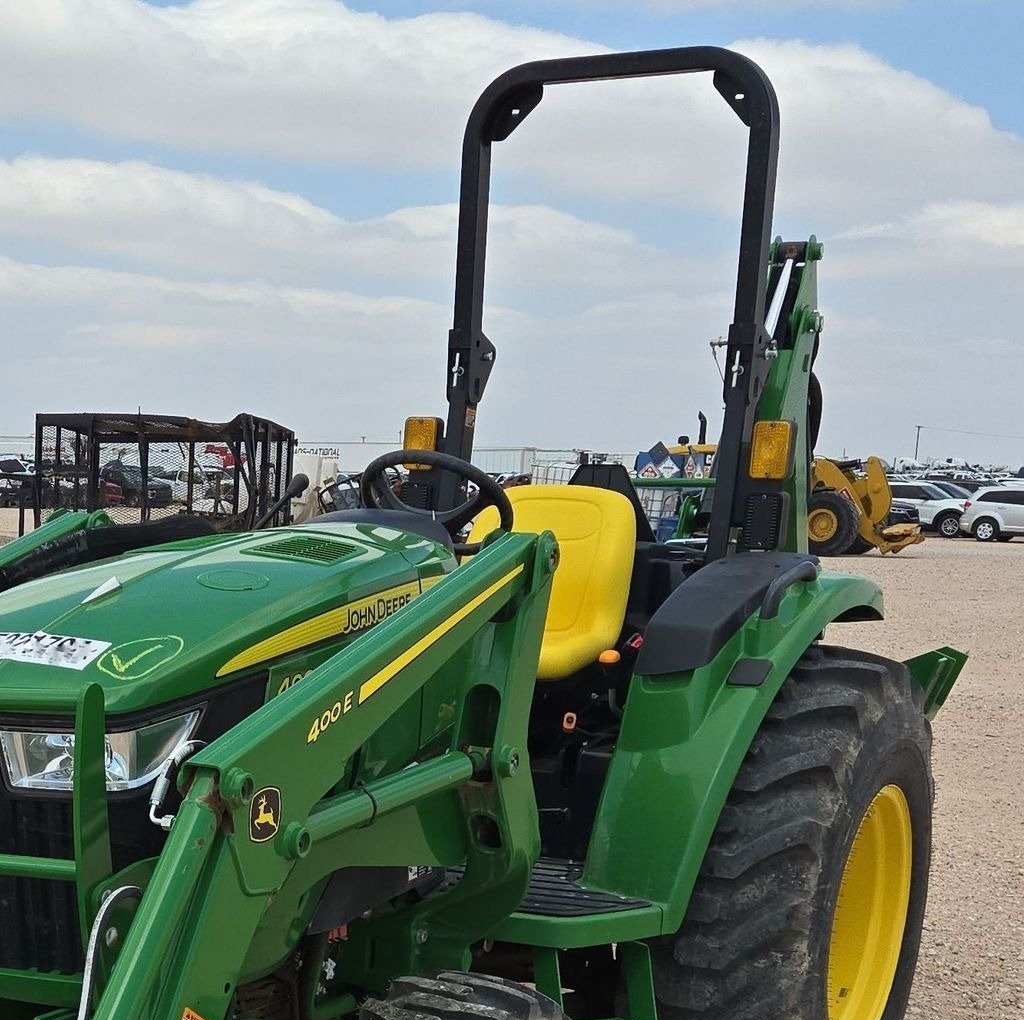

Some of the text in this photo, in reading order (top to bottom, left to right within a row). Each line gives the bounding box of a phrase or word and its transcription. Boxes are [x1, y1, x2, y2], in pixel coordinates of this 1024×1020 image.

[343, 592, 412, 633] JOHN DEERE
[306, 690, 355, 745] 400 E
